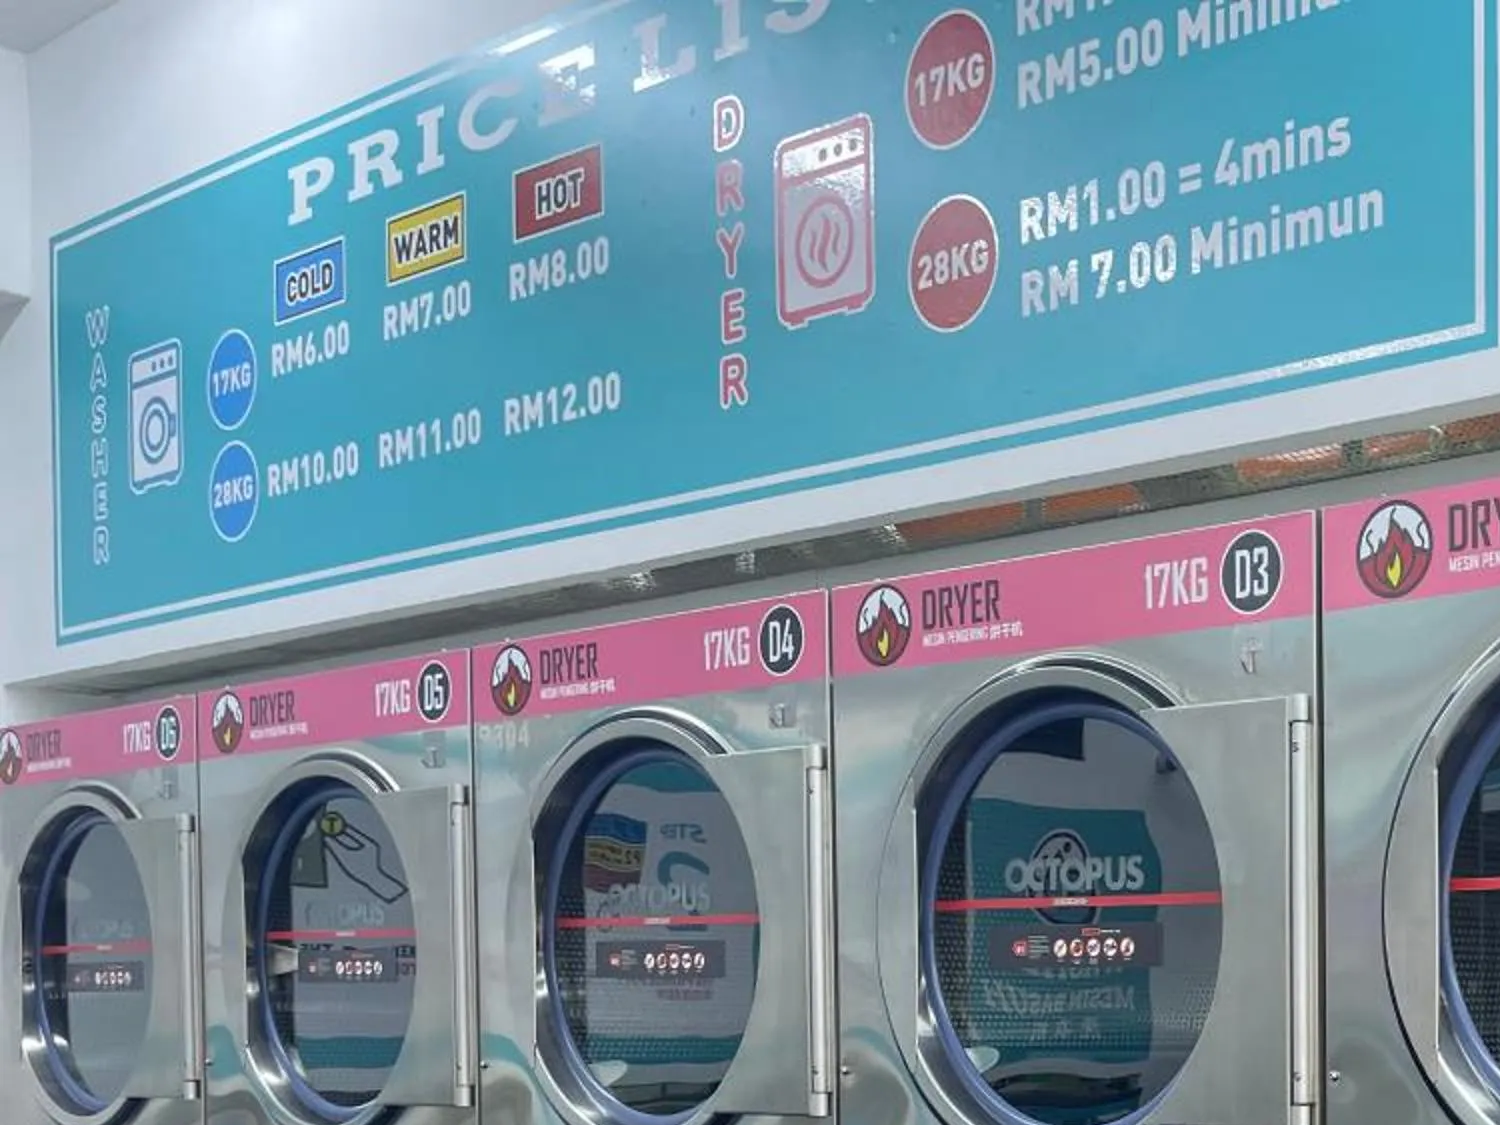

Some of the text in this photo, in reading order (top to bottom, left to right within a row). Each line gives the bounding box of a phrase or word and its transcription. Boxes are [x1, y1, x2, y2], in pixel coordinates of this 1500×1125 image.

[915, 52, 986, 106] 17KG
[1018, 38, 1164, 109] RM5.00
[287, 43, 597, 226] PRICE
[535, 170, 585, 220] HOT
[1020, 116, 1352, 245] RM1.00 = 4mins
[393, 214, 460, 265] WARM
[713, 94, 748, 409] DRYER
[917, 239, 989, 291] 28KG
[1020, 188, 1384, 317] RM 7.00 Minimun
[286, 259, 334, 306] COLD
[508, 236, 610, 303] RM8.00
[382, 281, 472, 343] RM7.00
[271, 321, 350, 378] RM6.00
[212, 362, 252, 399] 17KG
[503, 371, 622, 438] RM12.00
[378, 409, 482, 470] RM11.00
[213, 475, 254, 507] 28KG
[266, 440, 360, 498] RM10.00
[1144, 545, 1269, 610] 17KG D3
[922, 580, 1001, 630] DRYER
[539, 643, 598, 684] DRYER
[703, 624, 795, 672] 17KG D4
[250, 691, 296, 727] DRYER
[375, 679, 411, 717] 17KG
[27, 729, 61, 761] DRYER
[123, 721, 151, 754] 17KG
[1004, 855, 1146, 894] OCTOPUS
